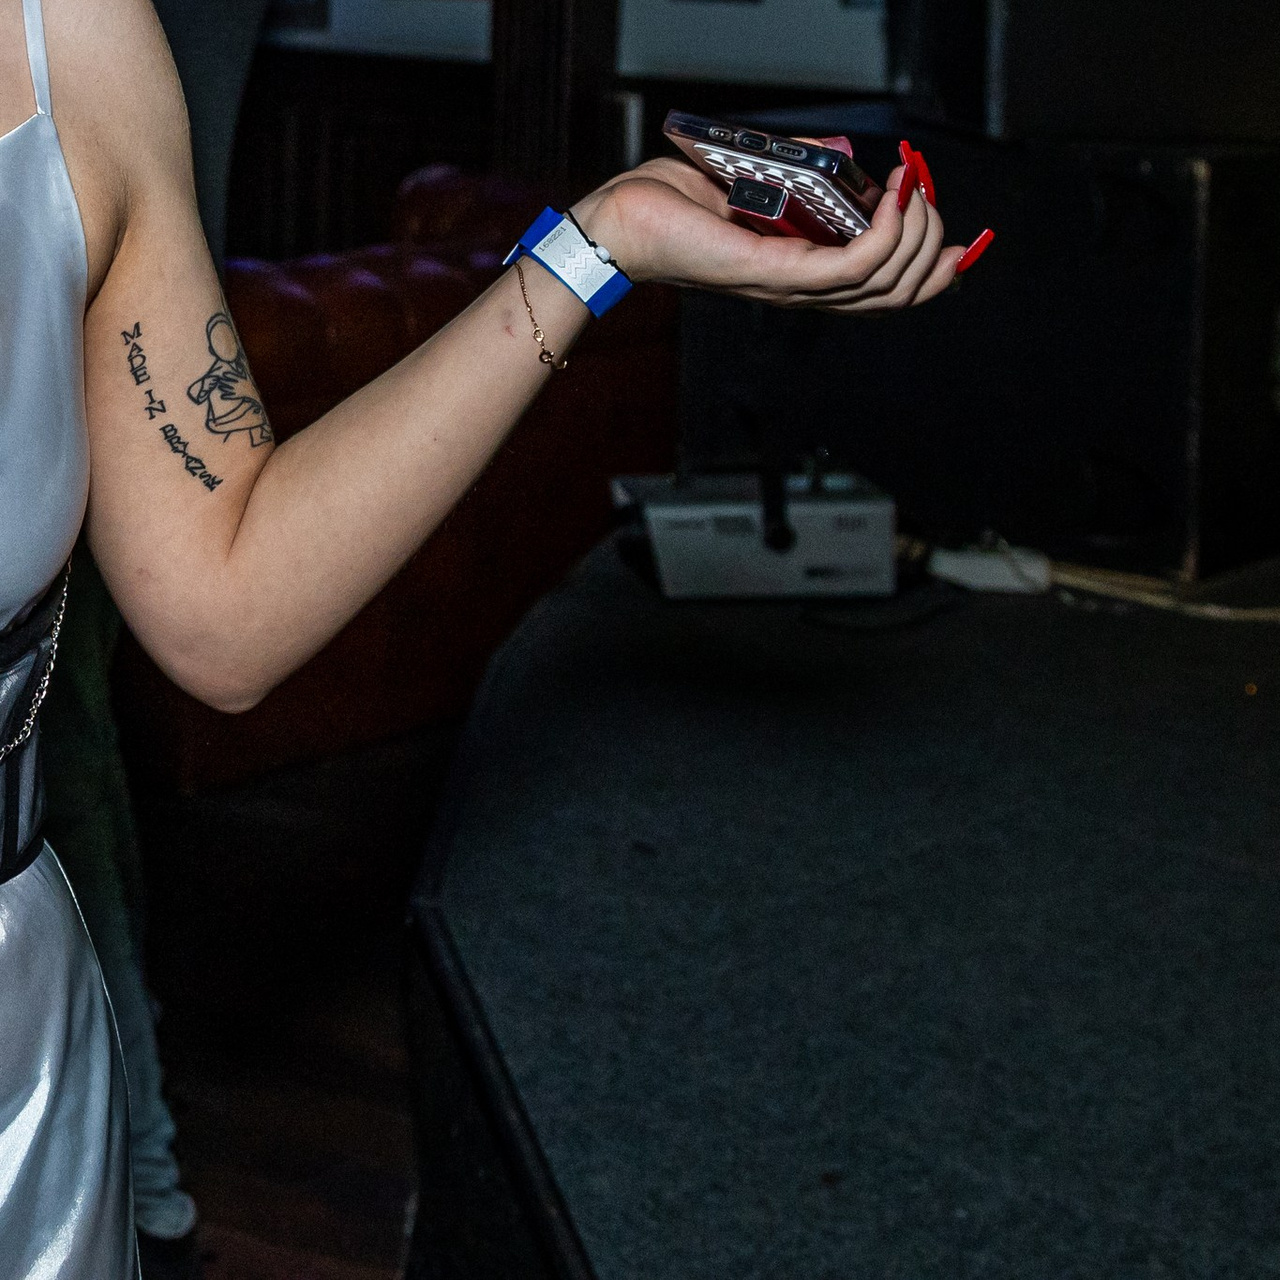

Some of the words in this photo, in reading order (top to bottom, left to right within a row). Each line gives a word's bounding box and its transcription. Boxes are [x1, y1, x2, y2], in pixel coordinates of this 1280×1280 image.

[538, 226, 567, 252] 168221
[121, 322, 150, 385] MADE
[144, 389, 166, 420] IN
[159, 424, 224, 491] BRYANSK
